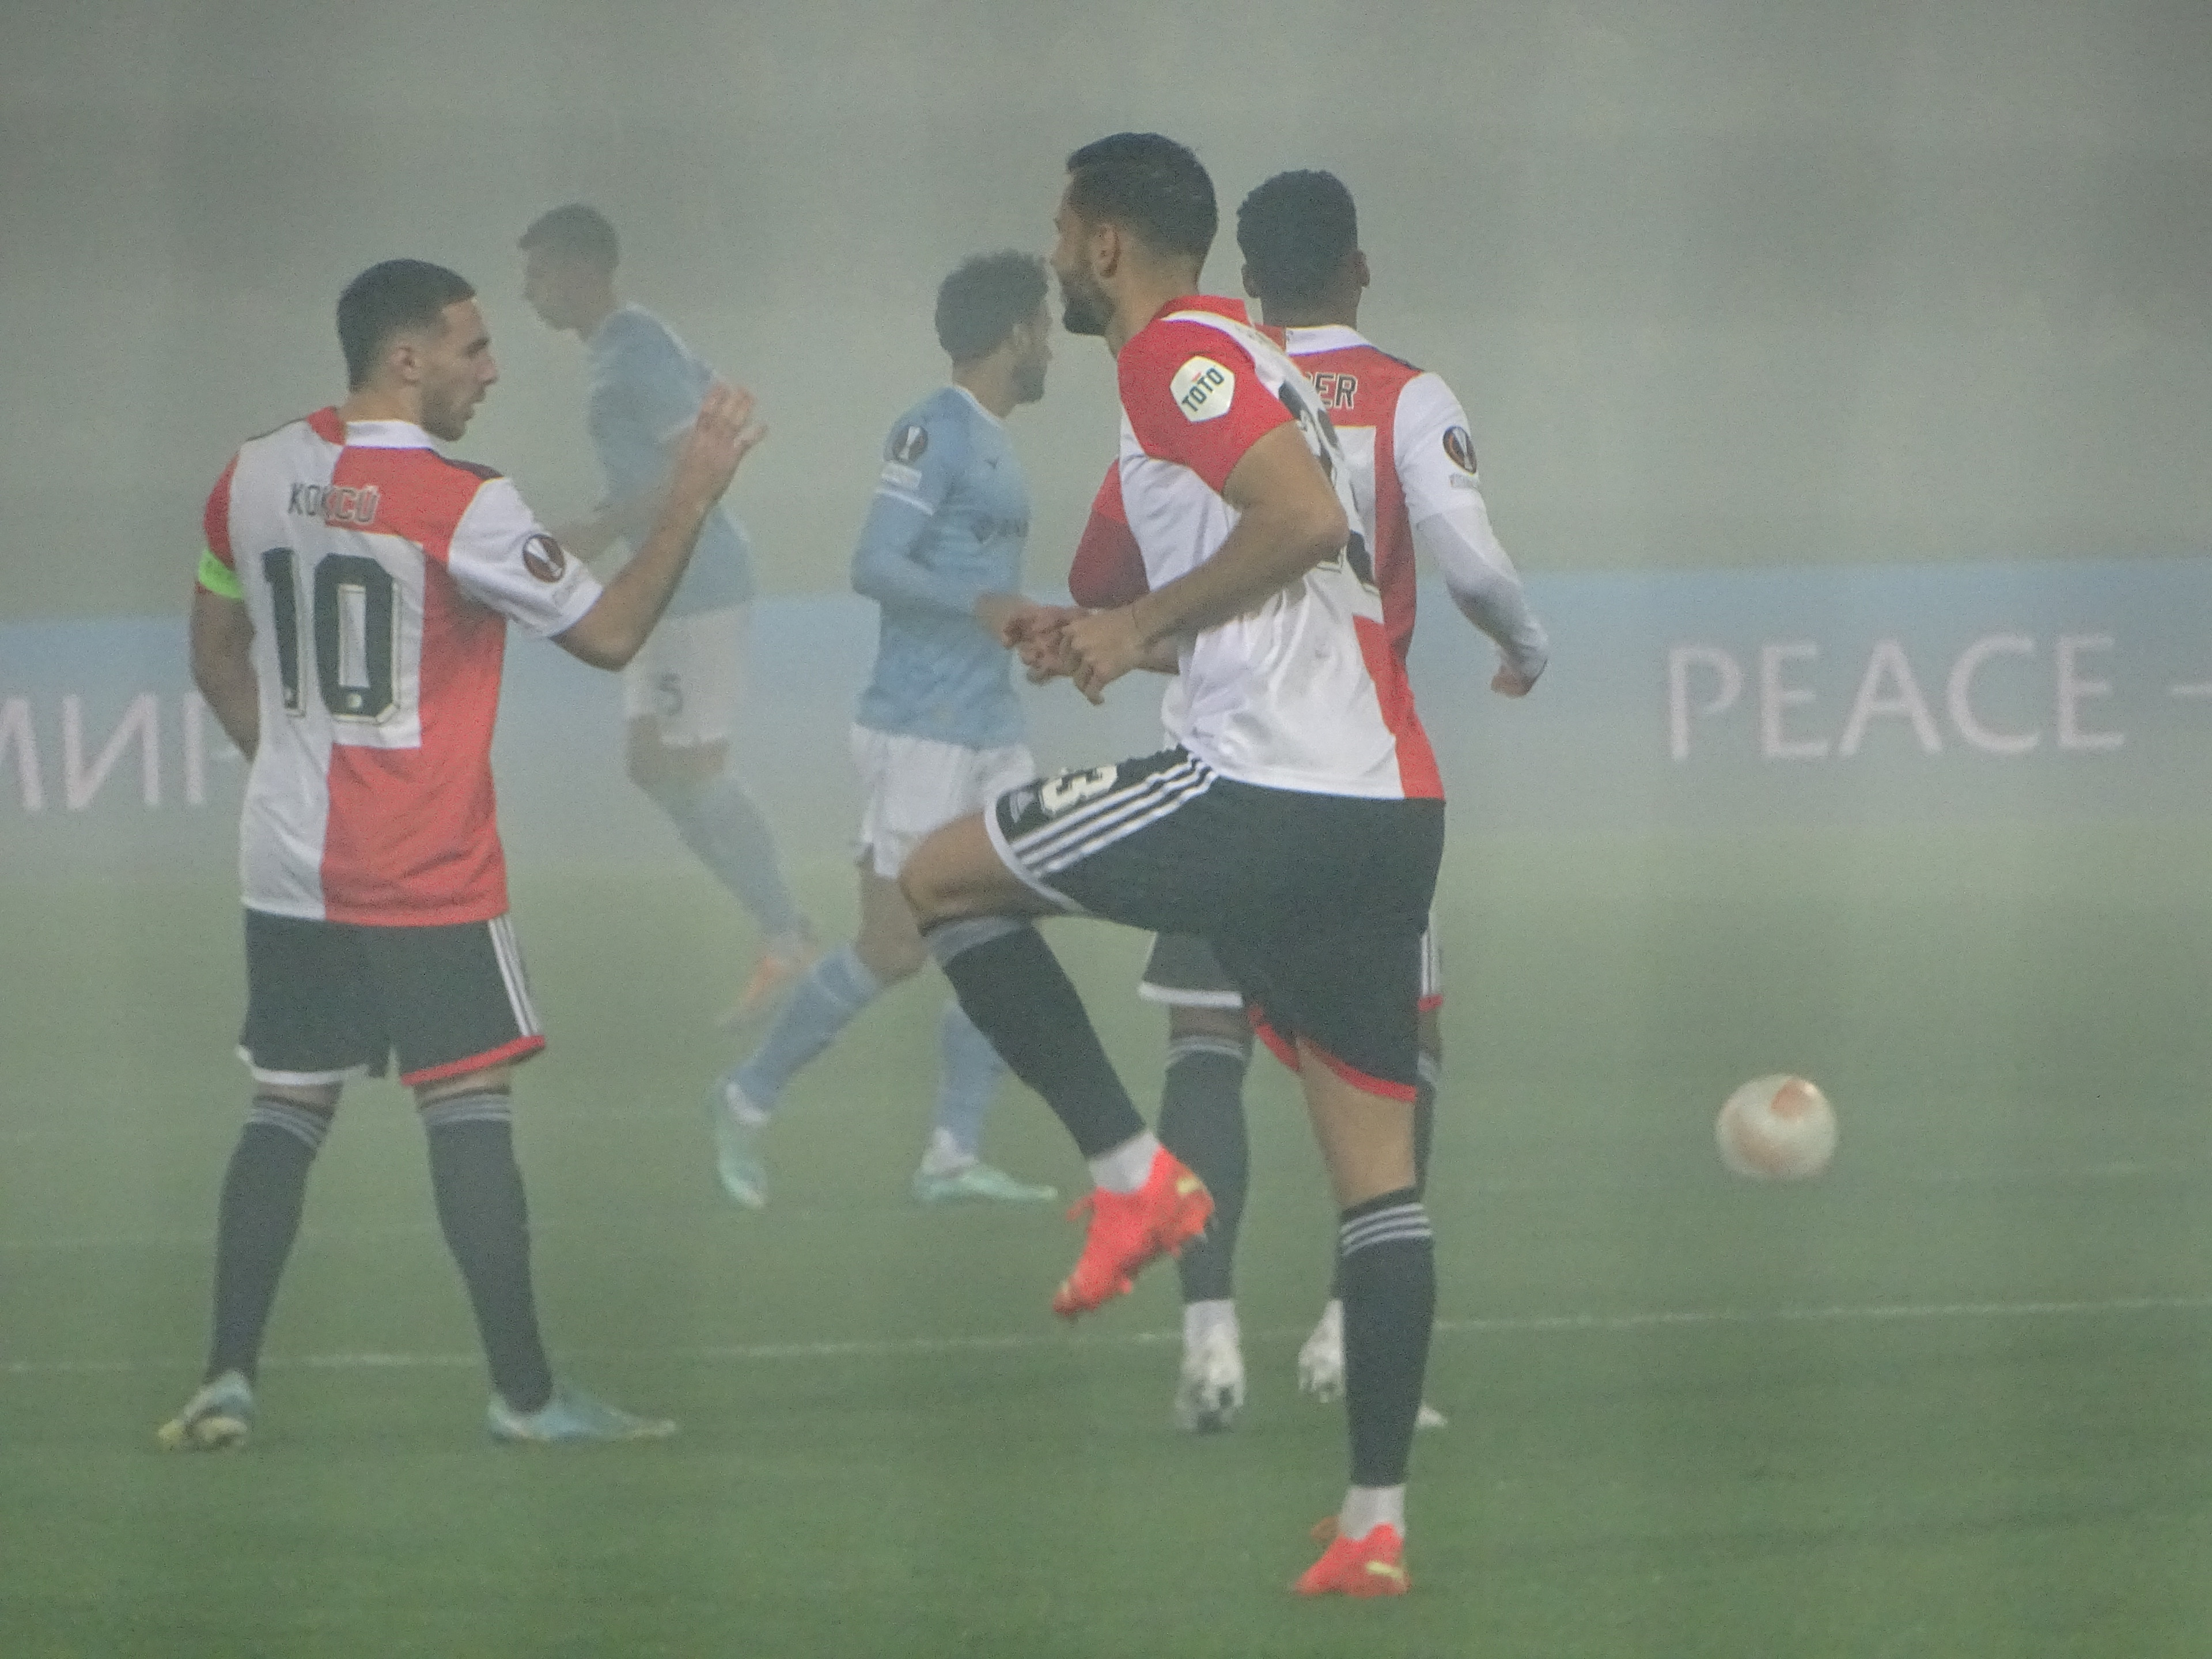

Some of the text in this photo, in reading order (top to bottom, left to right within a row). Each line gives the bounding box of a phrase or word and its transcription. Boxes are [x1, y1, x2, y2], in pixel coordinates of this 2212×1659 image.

[1181, 368, 1225, 412] TOTO
[261, 546, 403, 726] 10
[1668, 631, 2127, 763] PEACE
